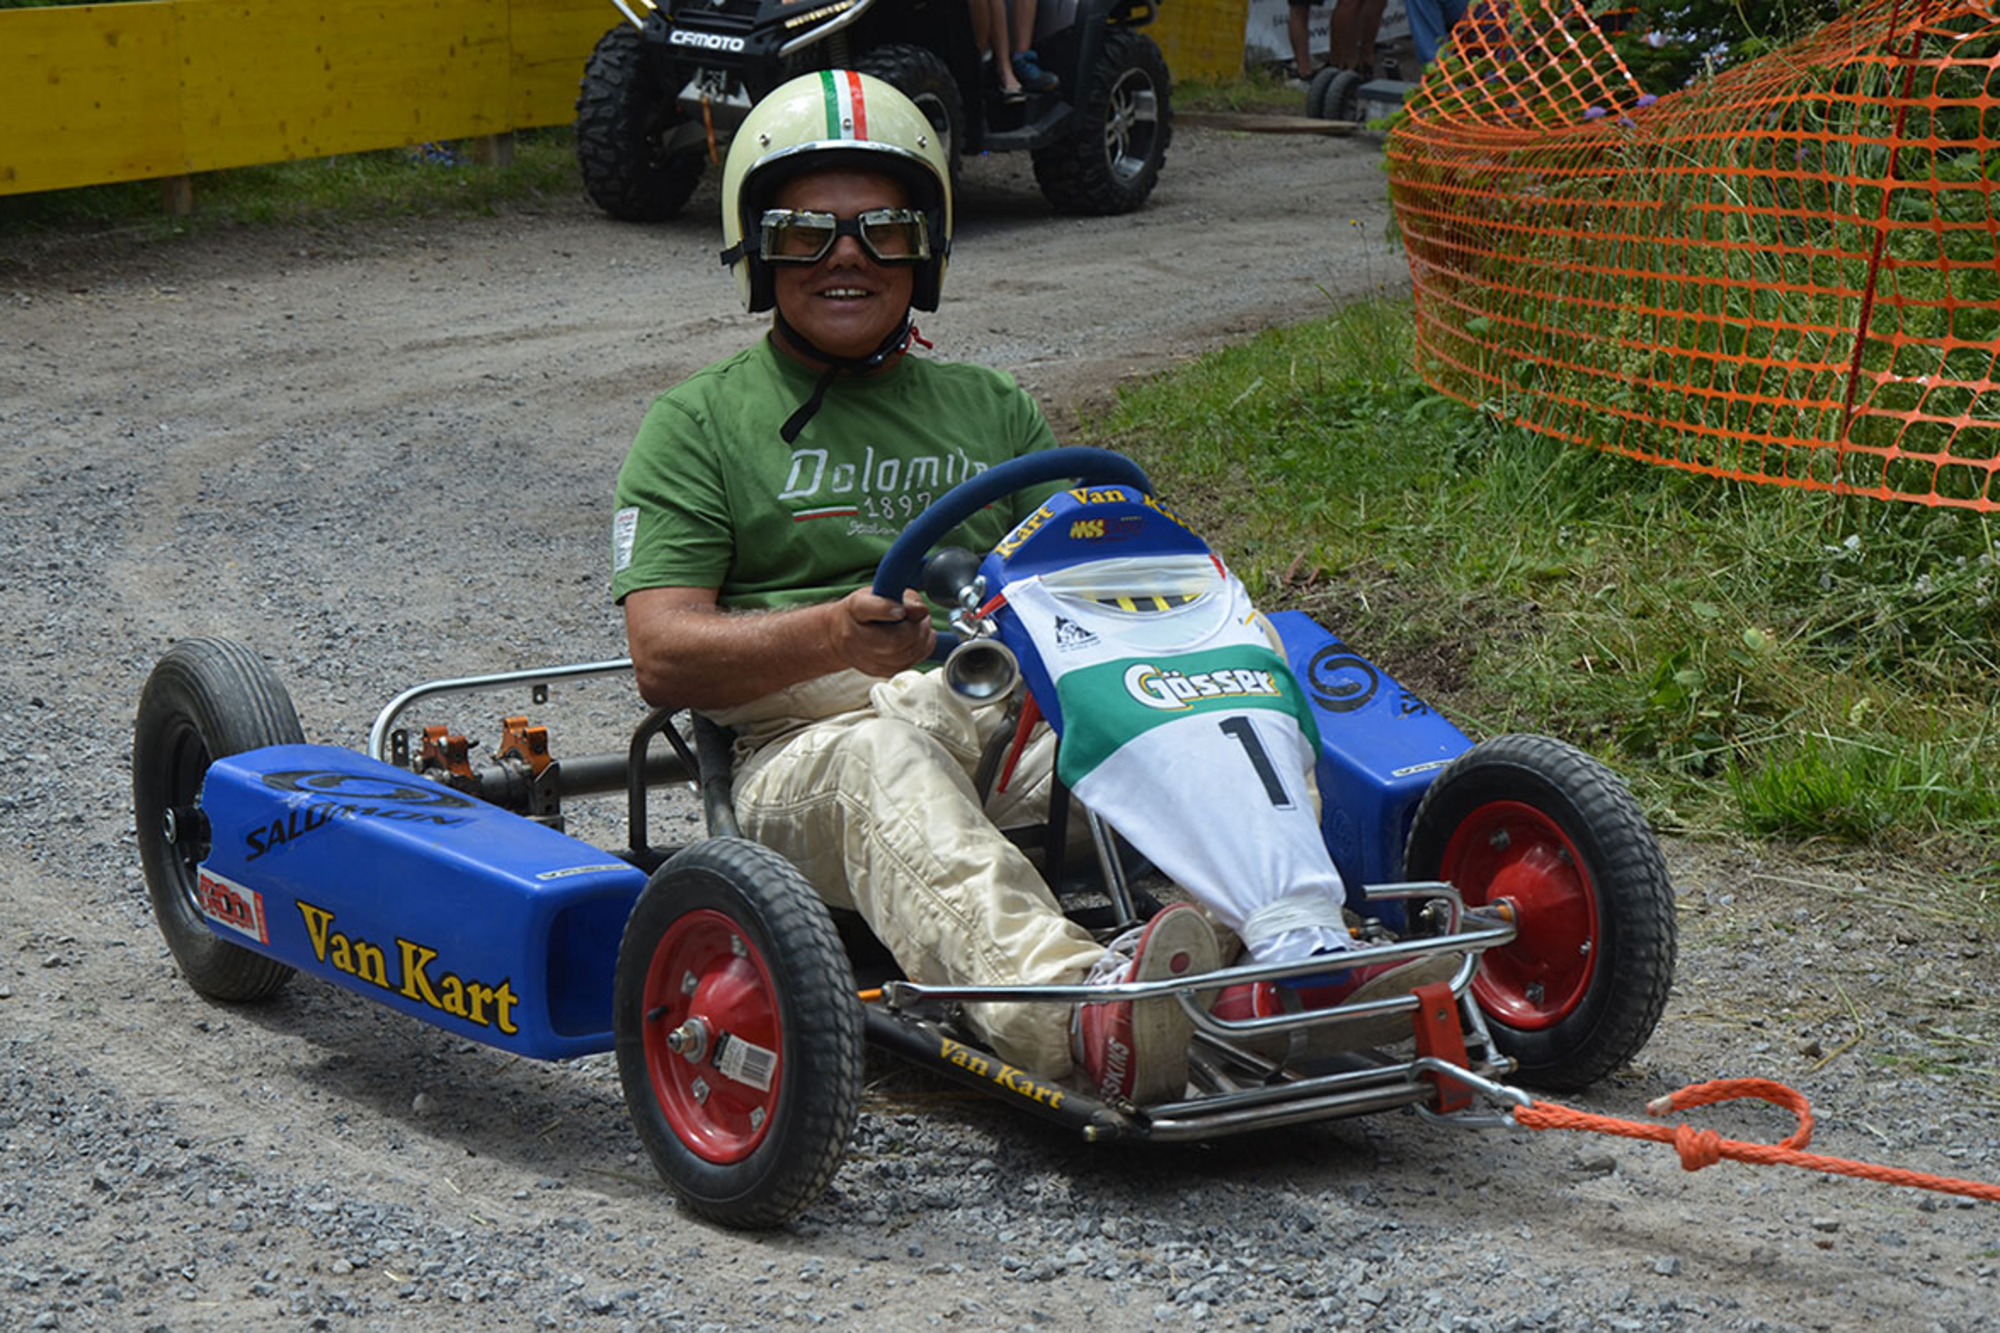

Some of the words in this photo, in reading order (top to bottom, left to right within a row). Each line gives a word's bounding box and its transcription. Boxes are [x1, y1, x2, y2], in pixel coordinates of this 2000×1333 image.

[670, 30, 745, 52] CFMOTO
[993, 505, 1055, 559] Kart
[1067, 488, 1129, 505] Van
[1123, 663, 1282, 710] Gösser
[1218, 716, 1297, 811] 1
[245, 801, 470, 861] SALOMON
[296, 899, 392, 989] Van
[395, 935, 519, 1036] Kart
[939, 1036, 989, 1077] Van
[993, 1064, 1067, 1110] Kart
